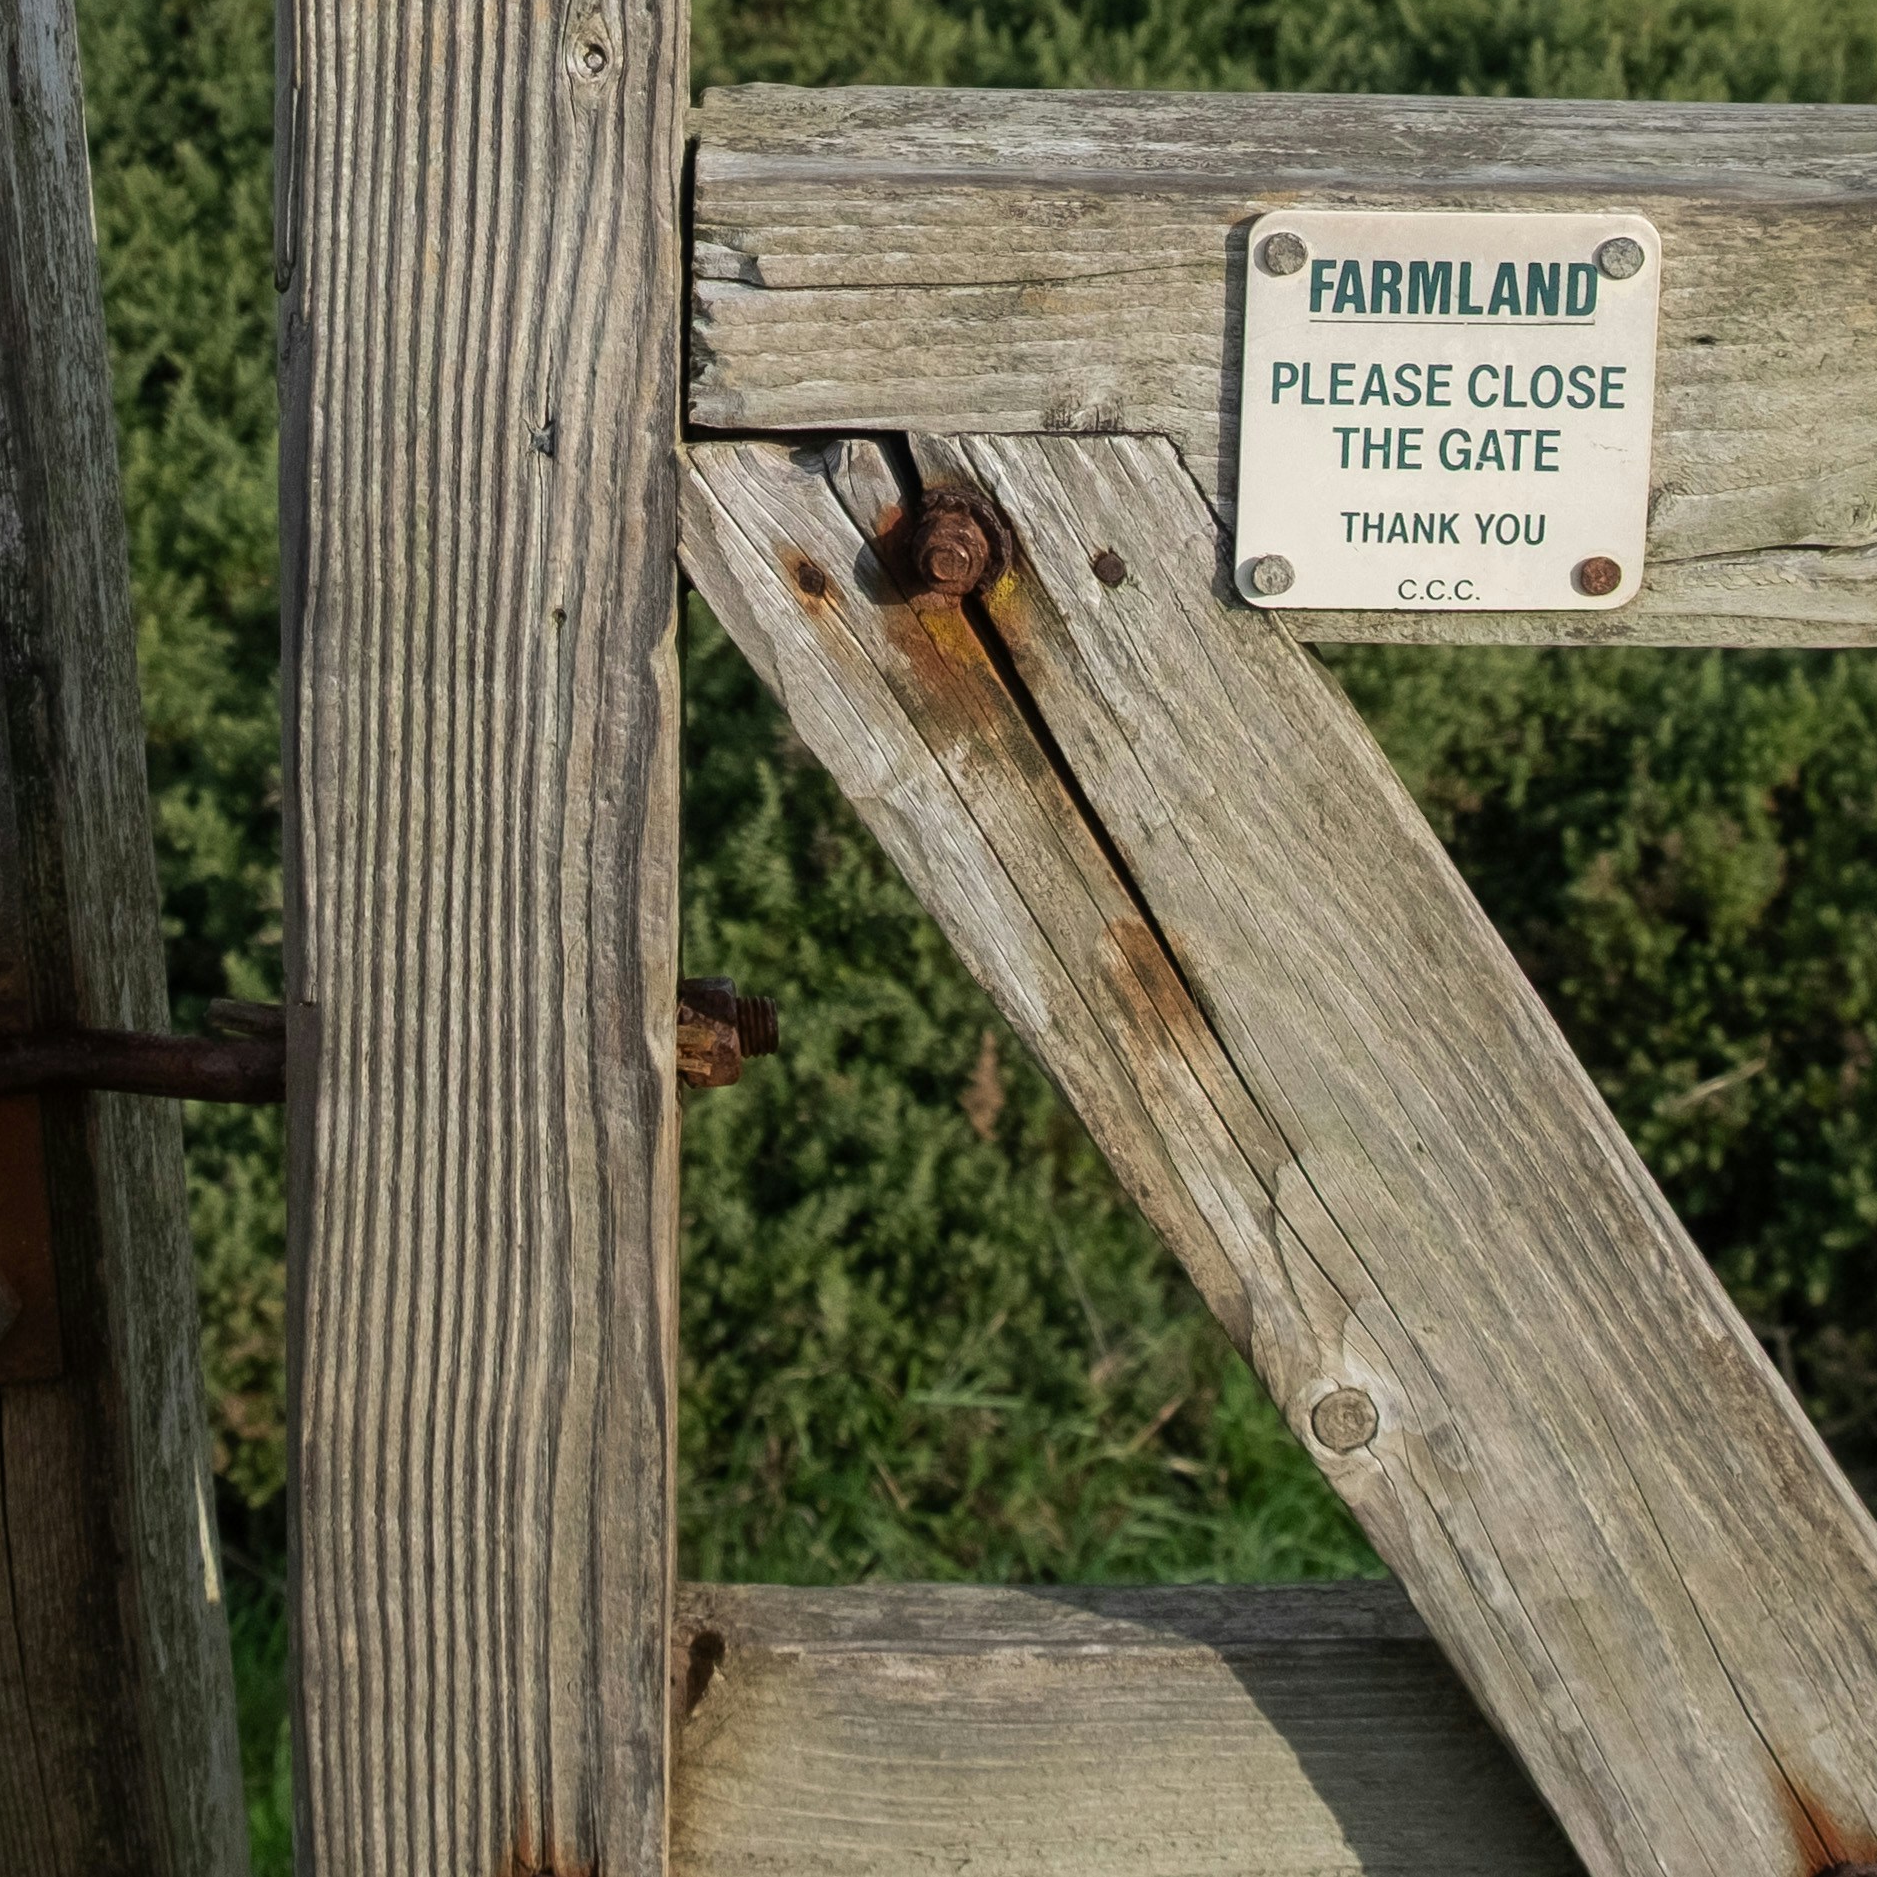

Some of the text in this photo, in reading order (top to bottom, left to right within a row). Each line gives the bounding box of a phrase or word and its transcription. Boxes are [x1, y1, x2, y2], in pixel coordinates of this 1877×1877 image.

[1308, 259, 1599, 317] FARMLAND
[1271, 361, 1628, 410] PLEASE CLOSE
[1332, 426, 1562, 472] THE GATE
[1340, 511, 1546, 546] THANK YOU
[1397, 578, 1481, 602] C.C.C.
